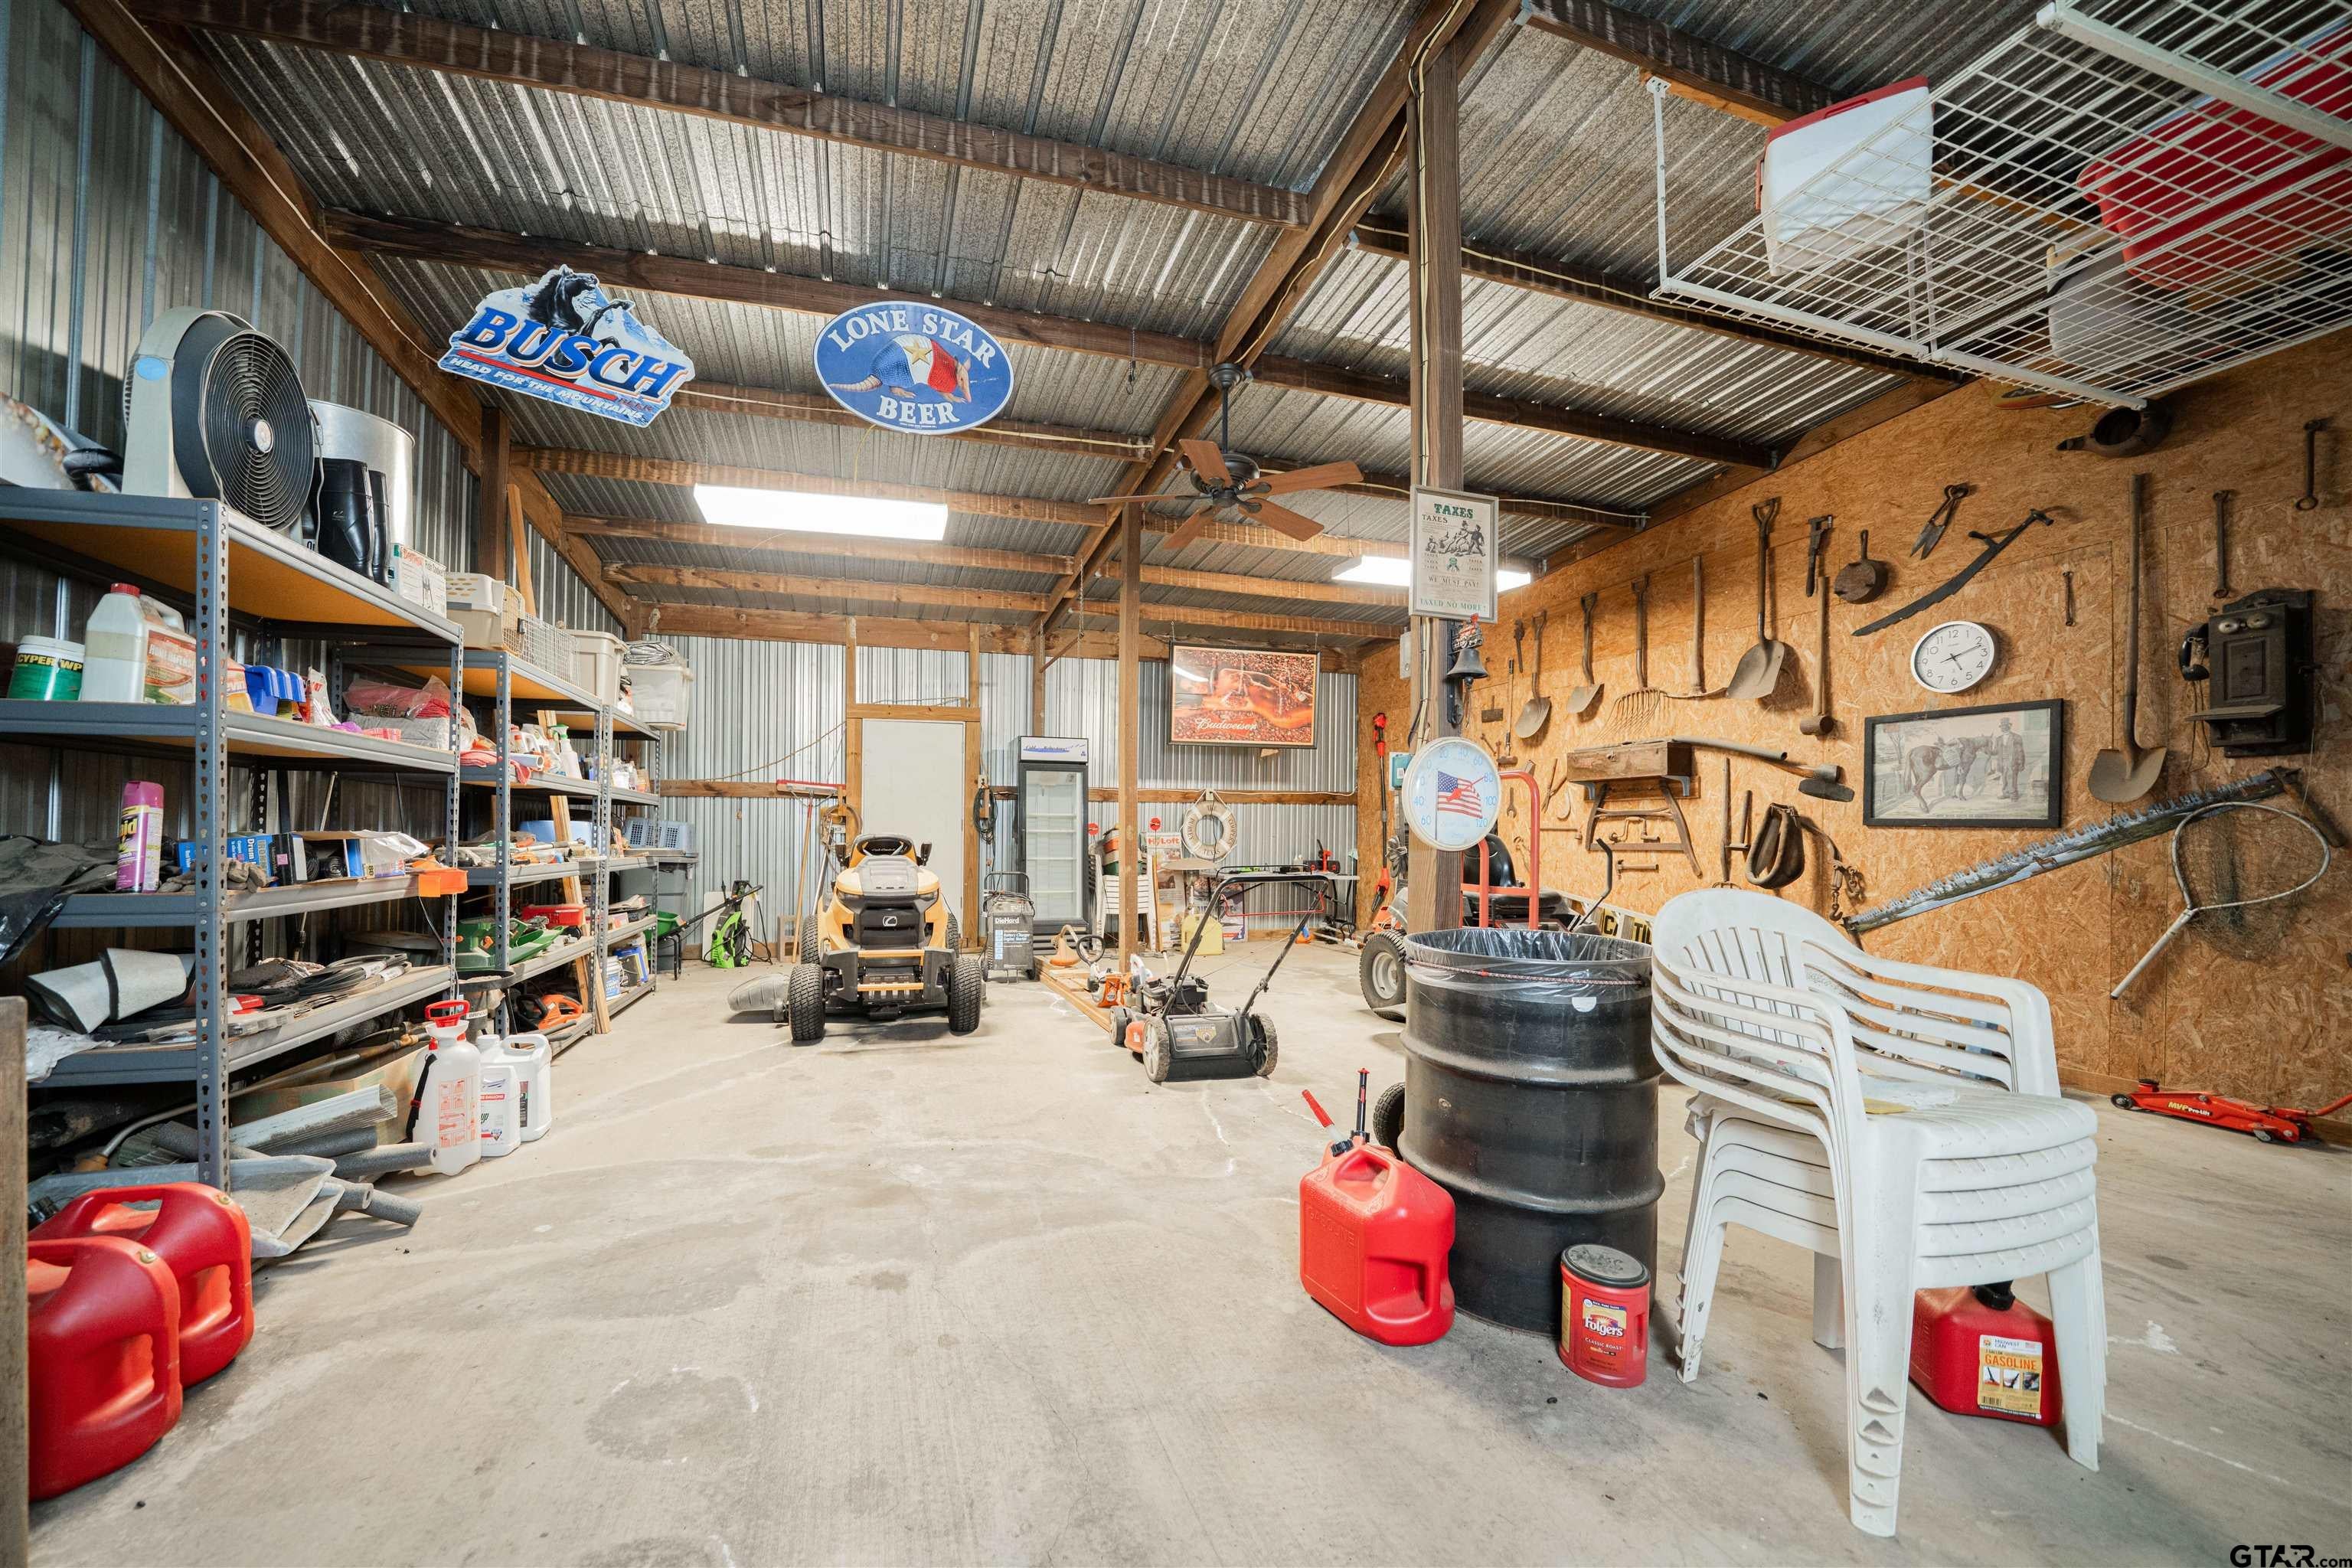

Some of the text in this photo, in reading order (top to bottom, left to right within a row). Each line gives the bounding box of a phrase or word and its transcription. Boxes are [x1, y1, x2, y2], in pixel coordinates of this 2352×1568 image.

[828, 309, 996, 369] LONE STAR
[459, 307, 688, 403] BUSCH
[450, 357, 644, 419] HEAD FOR THE MOUNTAINS
[876, 395, 960, 425] BEER
[1434, 503, 1474, 519] TAXES
[1422, 514, 1448, 524] TAXES
[1420, 598, 1444, 607] TAXED
[1948, 629, 1959, 639] 12
[1975, 636, 1983, 645] 2
[1926, 646, 1939, 655] 10
[1981, 648, 1988, 657] 3
[18, 654, 83, 671] CYPER WP
[1926, 669, 1933, 678] 8
[1966, 671, 1973, 680] 5
[1937, 675, 1944, 684] 7
[1951, 677, 1958, 685] 6
[1195, 717, 1257, 730] Budweiser
[1439, 750, 1449, 758] 20
[1474, 756, 1483, 766] 60
[1484, 772, 1493, 782] 80
[1414, 796, 1424, 806] 40
[1485, 796, 1497, 805] 100
[1421, 815, 1431, 825] 60
[1148, 837, 1180, 846] HyLoft
[1585, 1315, 1623, 1337] Folgers
[1585, 1337, 1622, 1351] CLASSIC ROAST
[1984, 1354, 2037, 1370] GASOLINE
